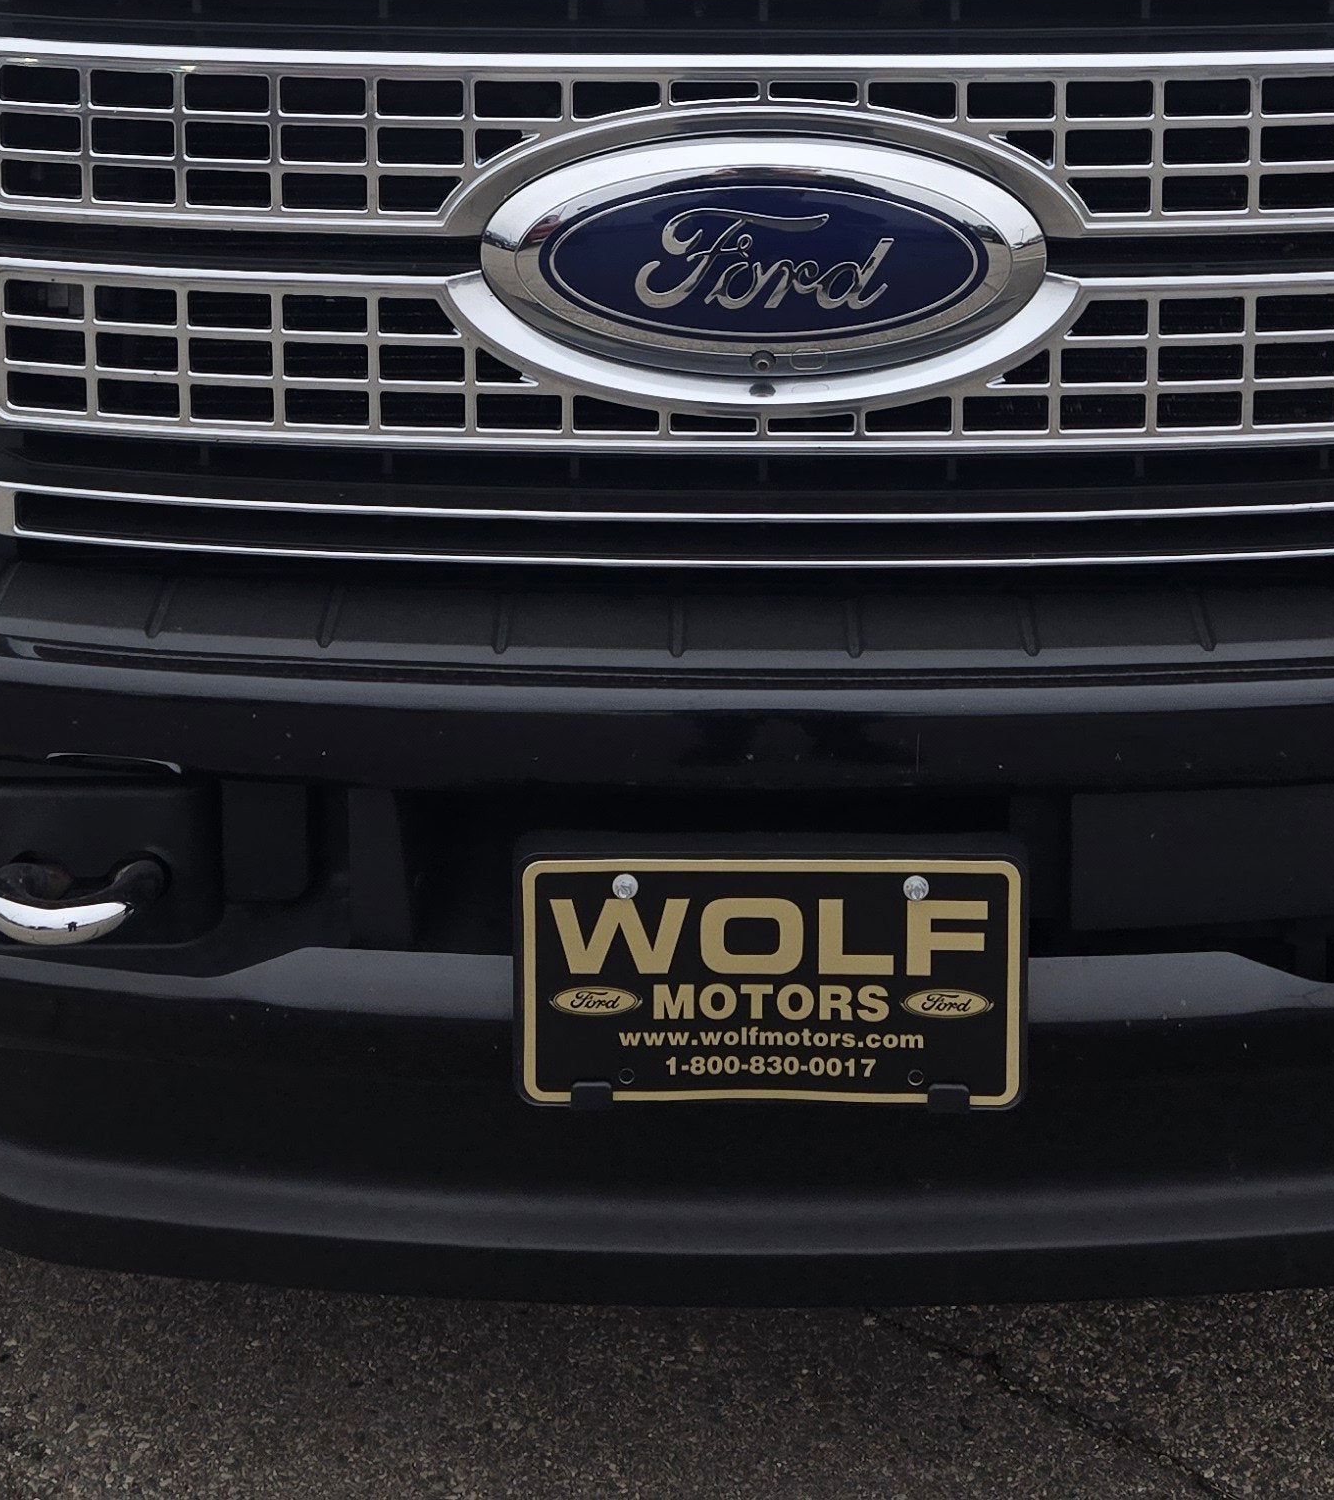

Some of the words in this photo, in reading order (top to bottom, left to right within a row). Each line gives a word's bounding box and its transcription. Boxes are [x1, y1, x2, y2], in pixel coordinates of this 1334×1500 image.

[634, 206, 896, 310] Ford
[549, 897, 989, 977] WOLF
[570, 990, 622, 1011] Ford
[652, 983, 890, 1022] MOTORS
[921, 992, 972, 1014] Ford
[618, 1027, 925, 1050] www.wolfmotors.com
[665, 1056, 878, 1078] 1-800-830-0017
